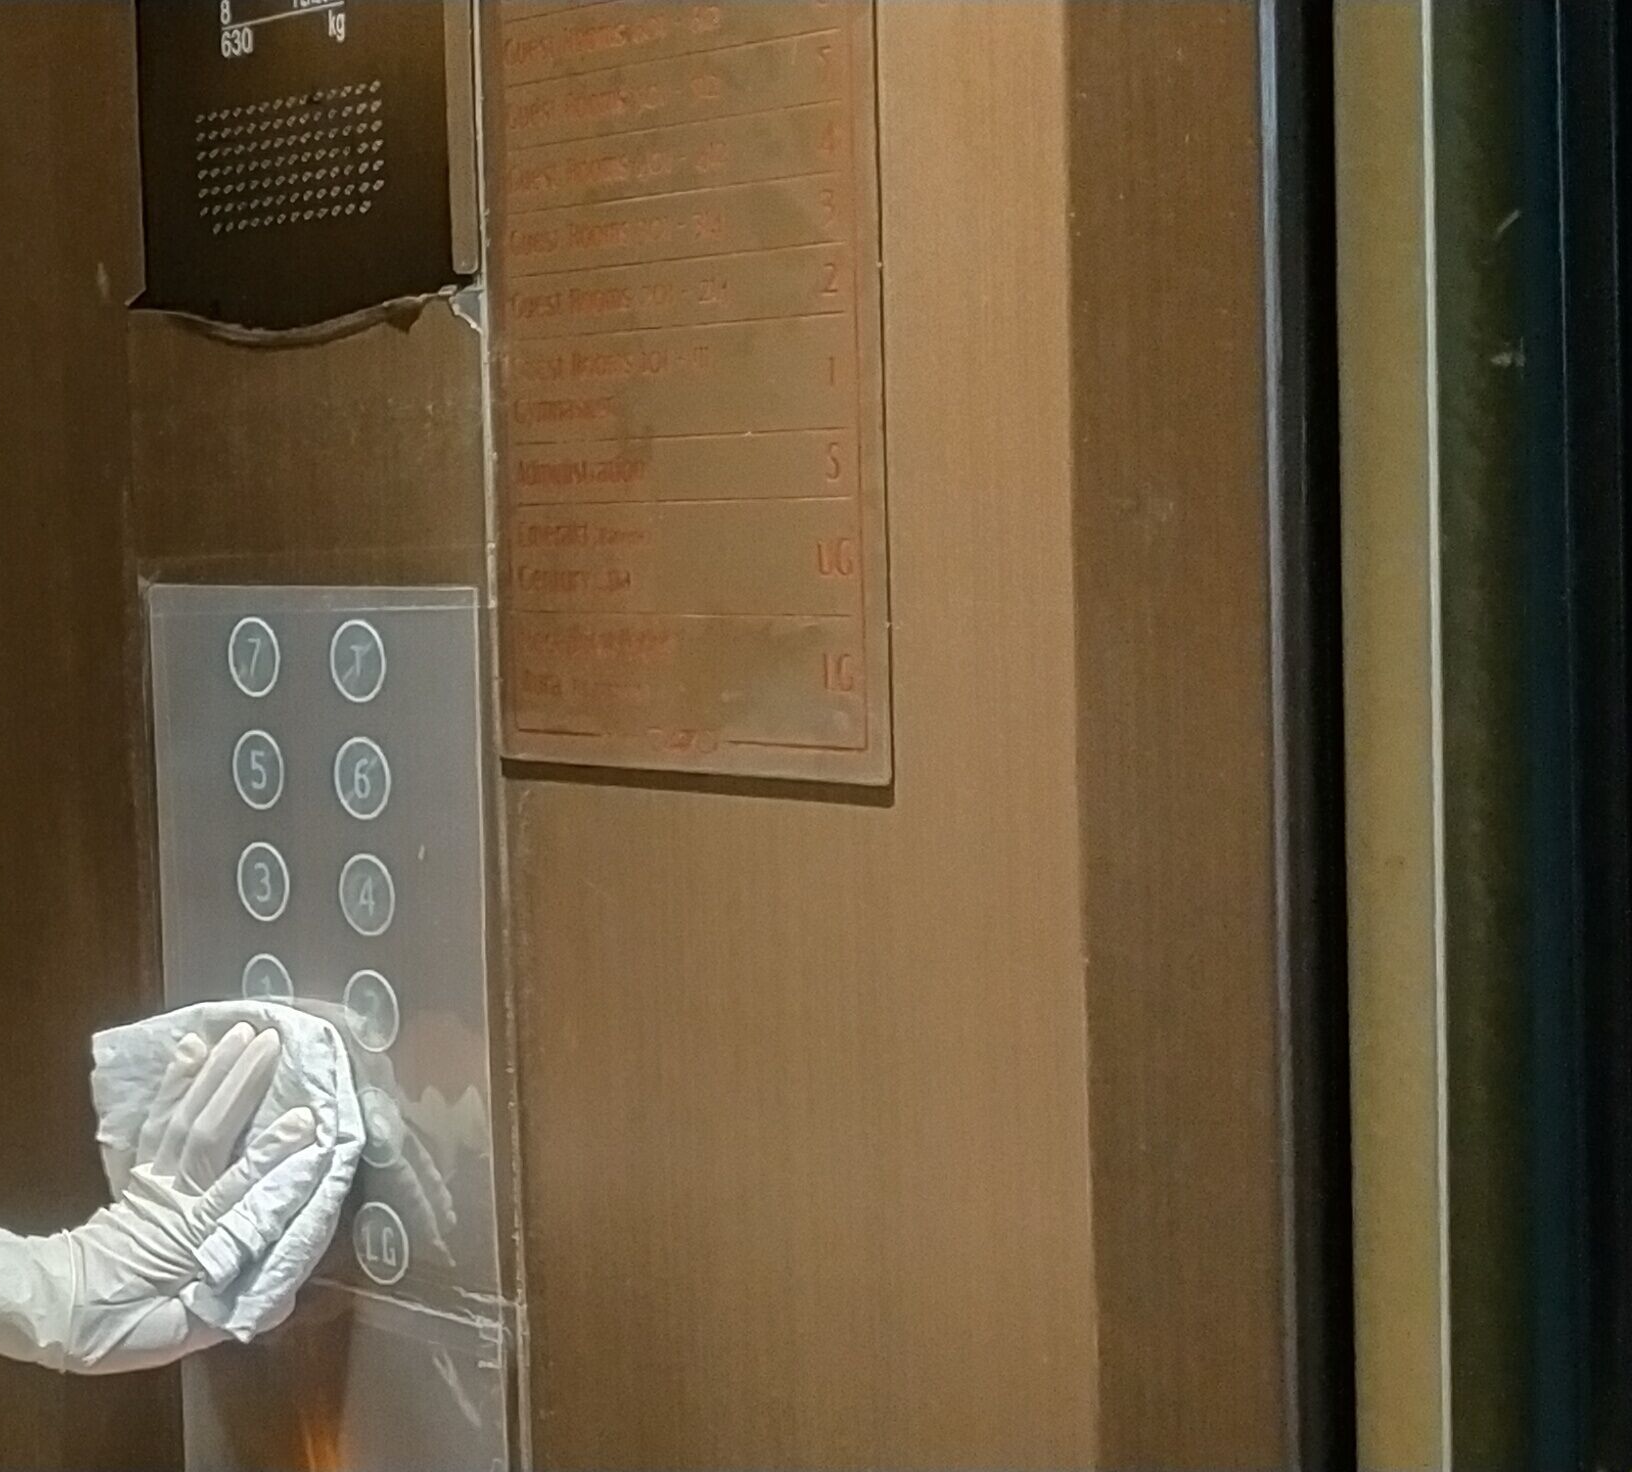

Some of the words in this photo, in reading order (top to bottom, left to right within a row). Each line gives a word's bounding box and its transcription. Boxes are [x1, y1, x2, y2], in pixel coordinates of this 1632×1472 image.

[220, 0, 231, 24] 8
[221, 27, 253, 58] 630
[328, 9, 345, 42] kg
[820, 262, 839, 297] 2
[825, 442, 840, 480] S
[817, 538, 853, 577] UG
[248, 637, 262, 677] 7
[250, 750, 267, 789] 5
[354, 757, 371, 799] 6
[253, 862, 271, 902] 3
[359, 876, 376, 916] 4
[361, 1222, 397, 1267] LG
